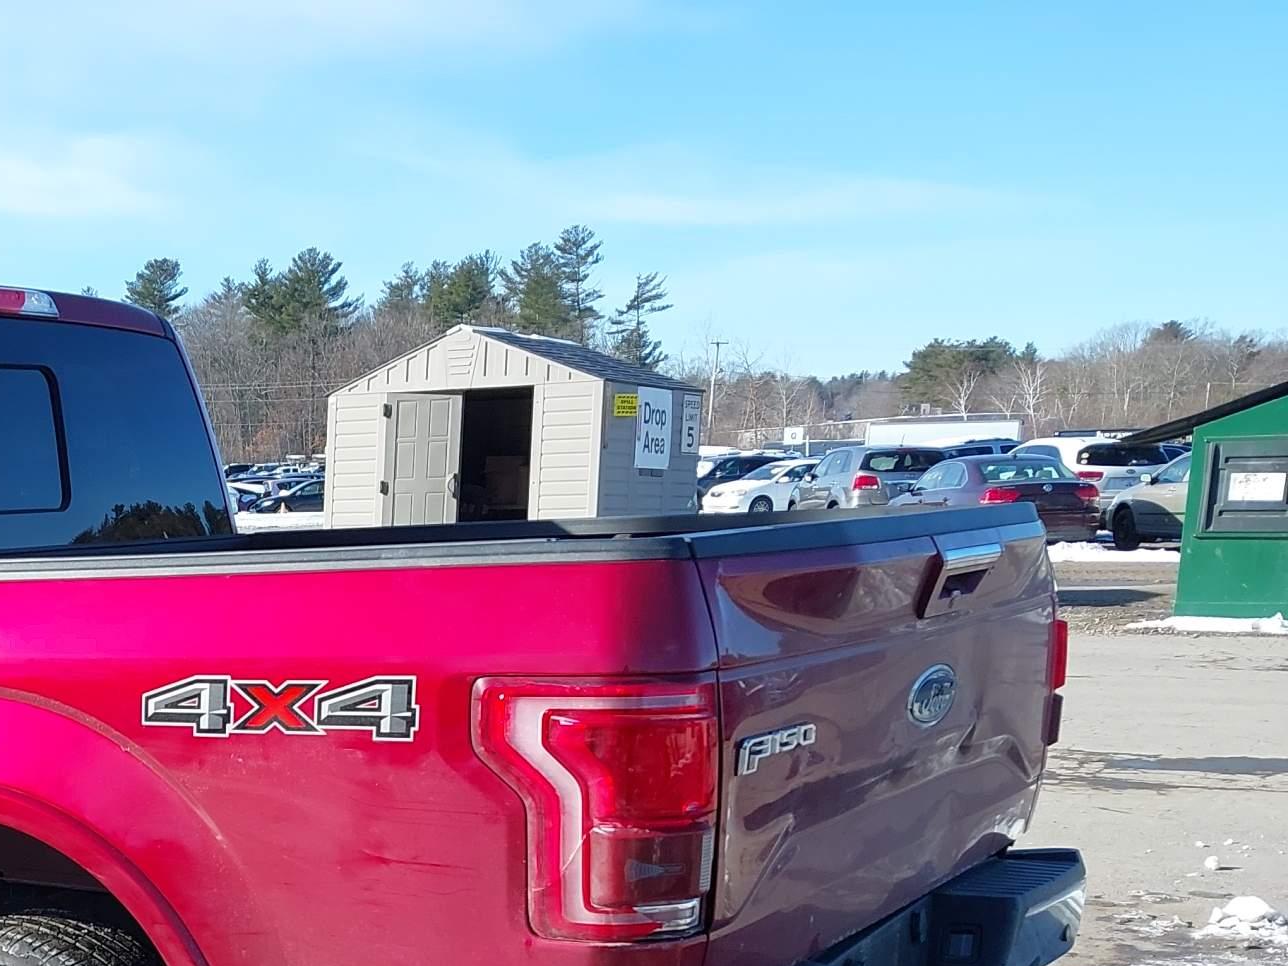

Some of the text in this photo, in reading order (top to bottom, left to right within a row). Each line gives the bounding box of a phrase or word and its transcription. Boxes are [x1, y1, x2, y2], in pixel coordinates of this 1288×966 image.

[643, 401, 667, 430] Drop
[685, 400, 700, 409] SPEED
[685, 413, 698, 422] LIMIT
[642, 430, 666, 455] Area
[687, 426, 695, 448] 5
[141, 675, 420, 742] 4X4
